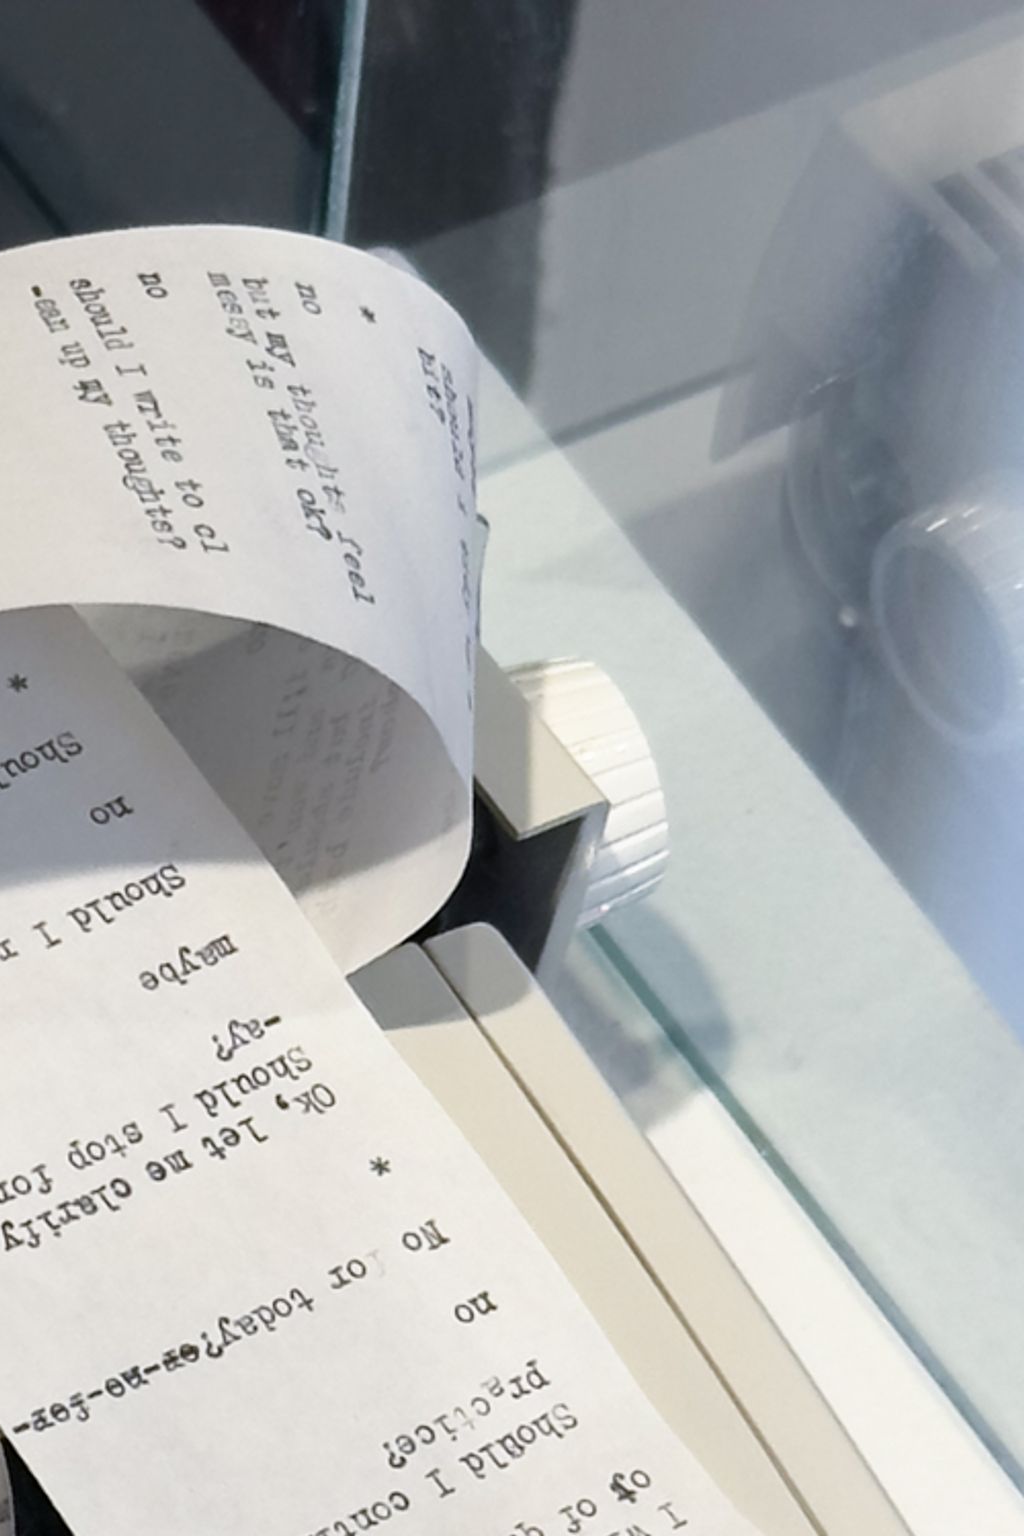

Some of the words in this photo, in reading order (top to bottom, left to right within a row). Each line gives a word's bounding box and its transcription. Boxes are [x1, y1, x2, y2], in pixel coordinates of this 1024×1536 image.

[135, 271, 170, 300] no
[293, 280, 323, 316] no
[68, 277, 135, 352] should
[114, 362, 149, 377] I
[132, 388, 184, 464] write
[173, 478, 205, 510] to
[192, 522, 231, 554] cl
[206, 270, 259, 347] messy
[244, 358, 276, 391] is
[266, 407, 311, 473] that
[295, 487, 334, 542] ok?
[57, 340, 92, 370] up
[101, 419, 188, 551] thoughts?
[240, 276, 282, 321] but
[264, 330, 297, 373] my
[336, 528, 377, 607] feel
[89, 795, 135, 826] no
[65, 861, 187, 934] Should
[31, 920, 64, 950] I
[137, 933, 240, 992] maybe
[210, 1014, 283, 1063] -ay?
[192, 1044, 314, 1118] Should
[273, 1075, 337, 1116] Ok,
[157, 1102, 190, 1135] I
[200, 1115, 270, 1161] let
[66, 1120, 145, 1171] stop
[144, 1148, 195, 1183] me
[0, 1176, 134, 1253] clarify
[400, 1218, 452, 1253] No
[453, 1289, 499, 1325] no
[381, 1358, 552, 1470] practice?
[457, 1402, 579, 1481] Should
[423, 1466, 457, 1500] I
[557, 1497, 598, 1536] of
[656, 1501, 689, 1531] I
